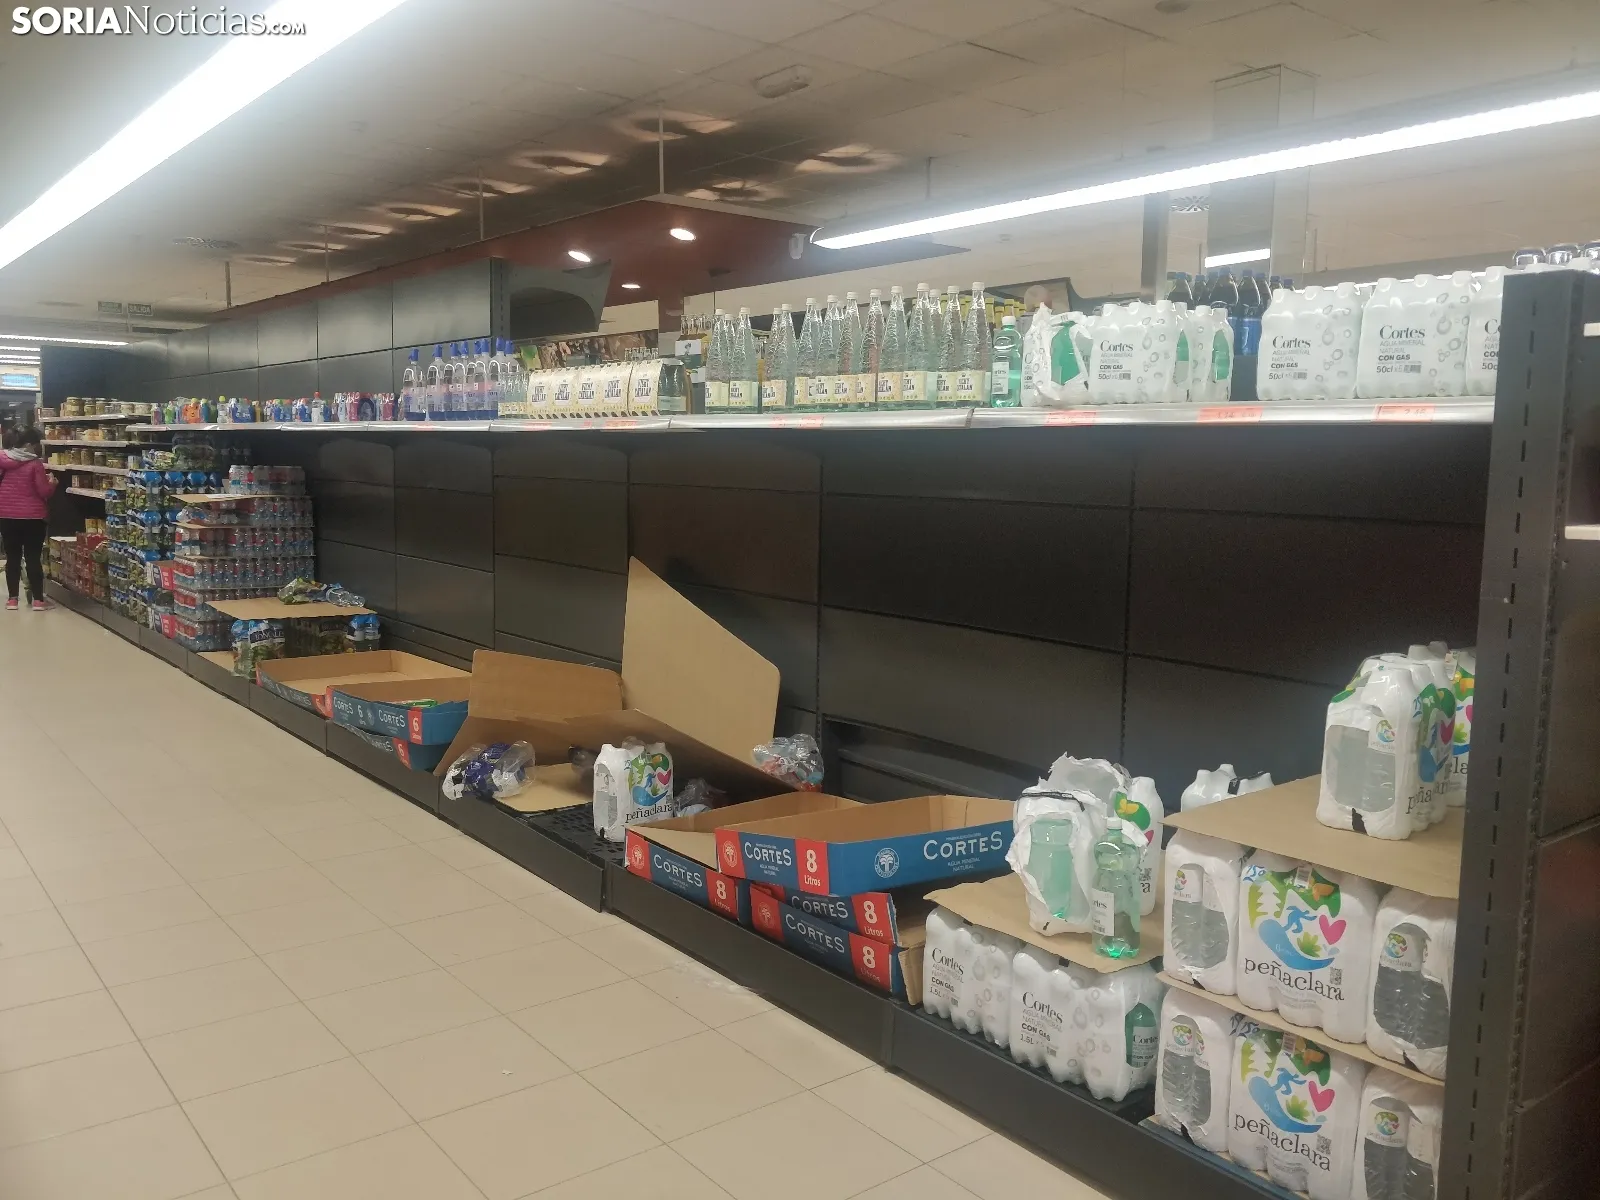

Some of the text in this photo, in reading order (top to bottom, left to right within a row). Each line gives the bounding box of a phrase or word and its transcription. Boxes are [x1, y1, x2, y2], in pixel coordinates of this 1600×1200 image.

[1380, 324, 1425, 340] Cortes
[1100, 340, 1134, 351] Cortes
[1272, 335, 1311, 349] Cortes
[1376, 365, 1393, 373] 50cl
[333, 696, 354, 715] CORTES
[357, 704, 364, 718] 6
[378, 709, 406, 728] CORTES
[412, 717, 420, 732] 6
[397, 743, 405, 757] 6
[624, 802, 673, 824] peñaclara
[744, 841, 792, 867] CORTES
[923, 830, 1003, 861] CORTES
[806, 849, 818, 873] 8
[952, 864, 975, 873] NATURAL
[653, 854, 703, 888] CORTES
[804, 874, 821, 887] Litros
[715, 880, 727, 900] 8
[714, 898, 731, 913] Litros
[791, 895, 849, 919] CORTES
[863, 900, 878, 924] 8
[785, 913, 845, 954] CORTES
[864, 926, 884, 937] Litros
[862, 946, 876, 969] 8
[931, 947, 965, 976] Cortes
[860, 967, 881, 983] Litros
[931, 976, 955, 993] CON GAS
[1244, 957, 1345, 1001] peñaclara
[1022, 991, 1063, 1024] Cortes
[1021, 1022, 1051, 1042] CON GAS
[1233, 1112, 1332, 1172] peñaclara
